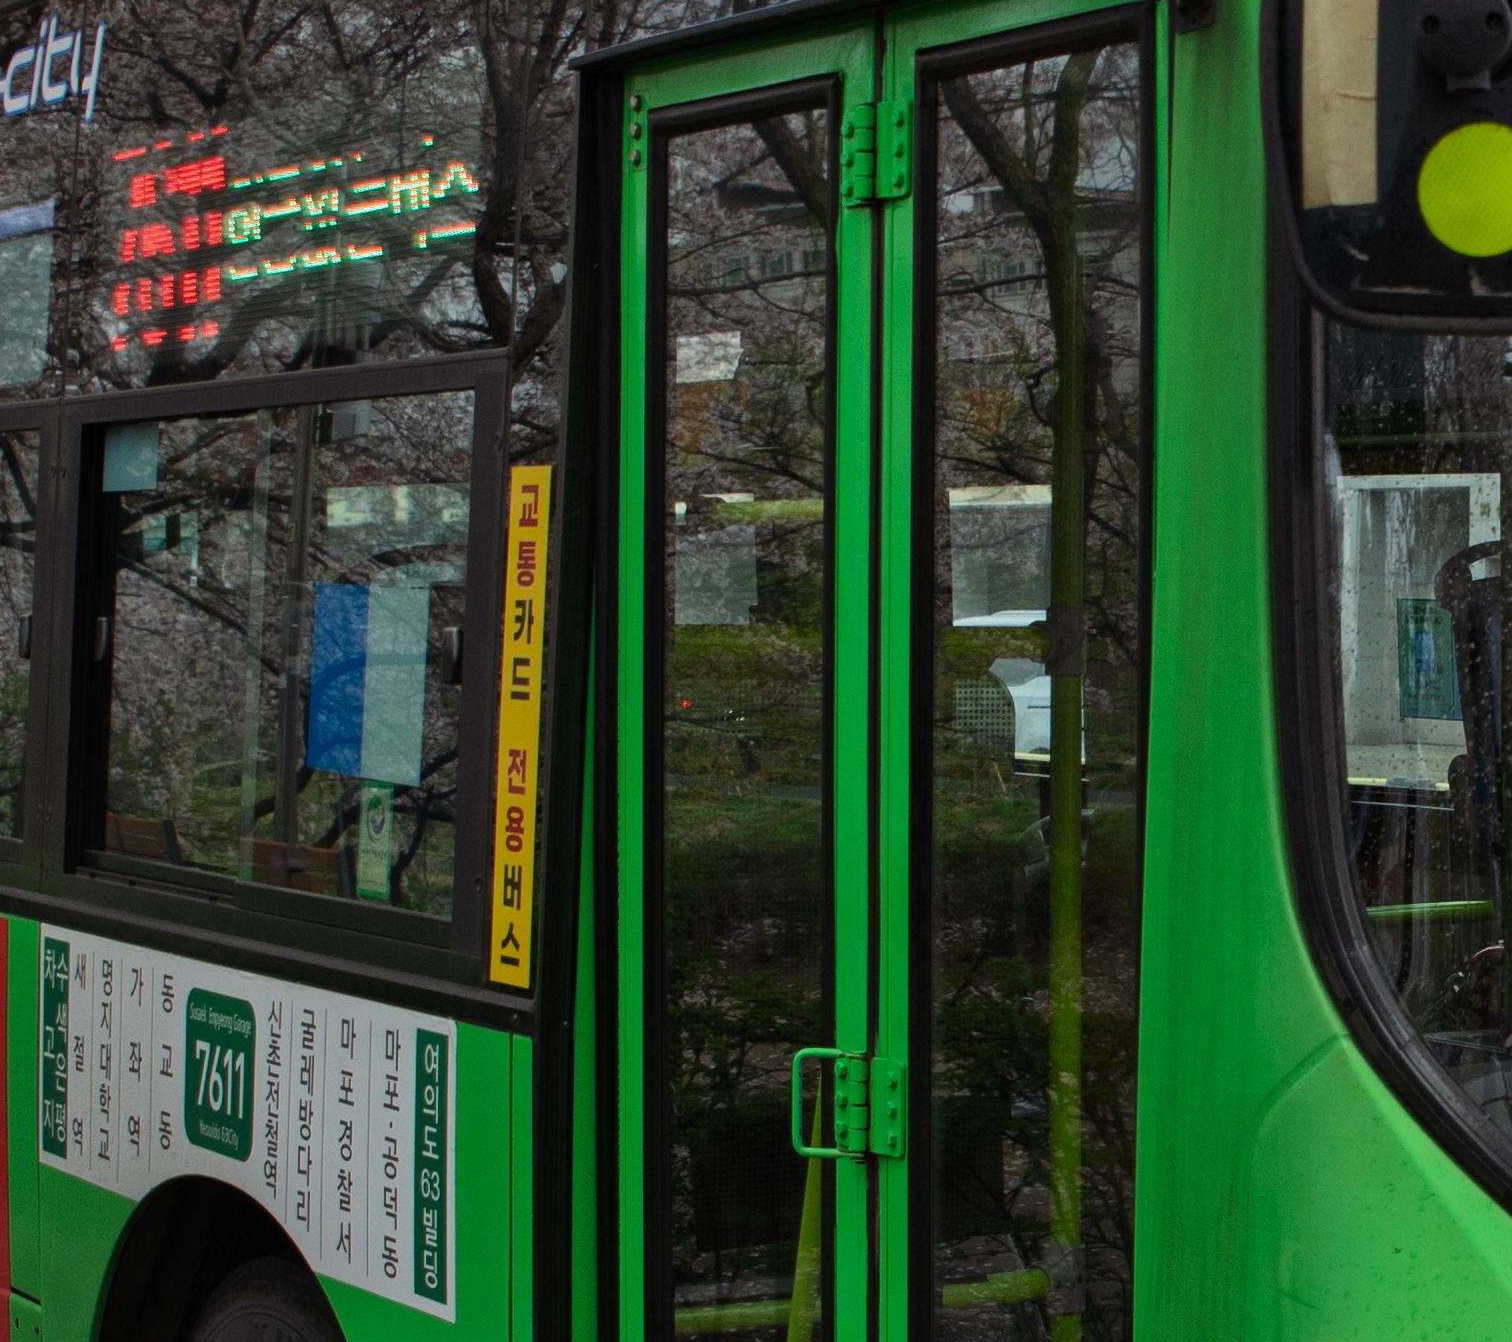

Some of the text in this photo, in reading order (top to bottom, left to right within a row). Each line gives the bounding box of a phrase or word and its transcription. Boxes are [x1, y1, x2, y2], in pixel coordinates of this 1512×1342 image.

[510, 484, 540, 702] 교통카드
[499, 748, 529, 968] 전용버스
[43, 949, 56, 1138] 차고지
[71, 953, 87, 1157] 새절역
[97, 959, 114, 1161] 명지대학교
[127, 966, 144, 1158] 가좌역
[159, 974, 175, 1152] 동교동
[194, 1040, 247, 1122] 7611
[264, 1000, 283, 1200] 신촌전철역
[296, 1009, 317, 1233] 굴레방다리
[336, 1017, 357, 1265] 마포경찰서
